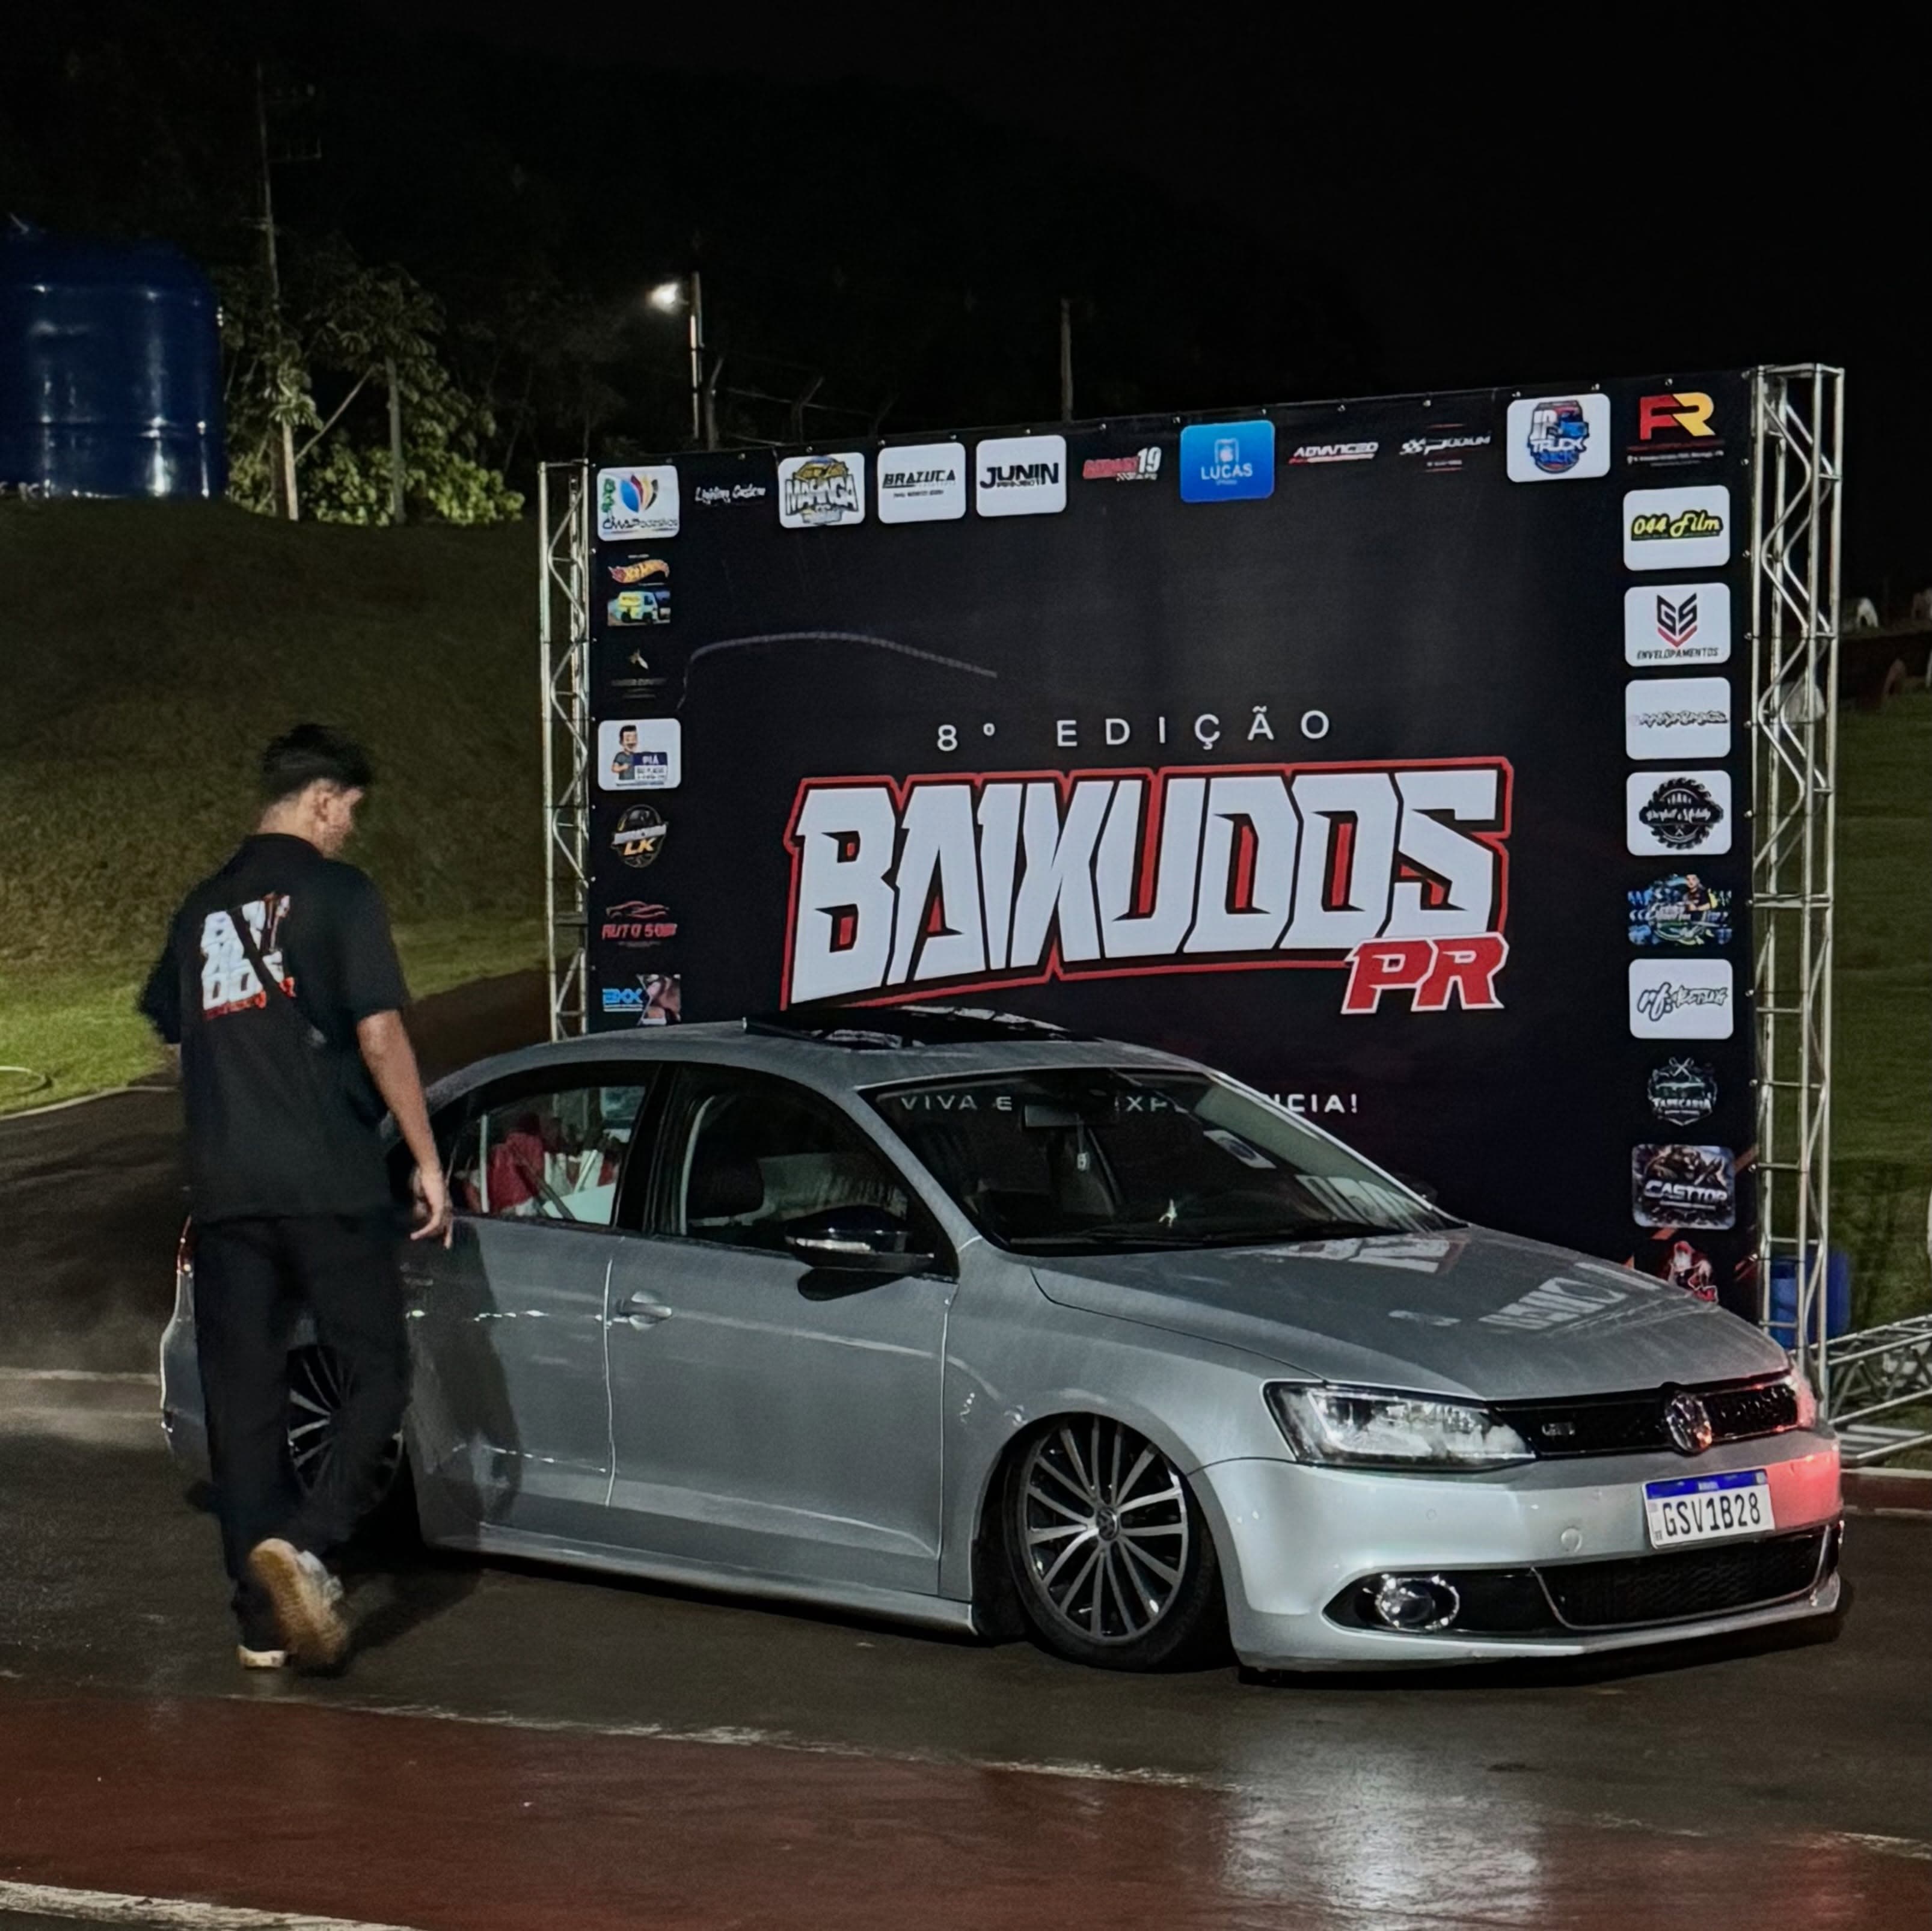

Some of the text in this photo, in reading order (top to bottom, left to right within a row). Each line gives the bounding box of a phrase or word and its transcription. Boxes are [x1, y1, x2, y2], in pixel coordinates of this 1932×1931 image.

[1639, 393, 1716, 440] FR
[980, 462, 1059, 489] JUNIN
[1201, 462, 1253, 480] LUCAS
[1637, 647, 1718, 660] ENVELOPAMENTOS
[1056, 706, 1330, 750] EDIÇÃO
[624, 837, 657, 855] LK
[783, 757, 1512, 1008] BAIXUDOS
[602, 924, 642, 940] AUTO
[1341, 932, 1509, 1014] PR
[901, 1095, 977, 1110] VIVA
[1662, 1492, 1761, 1537] GSV1B28
